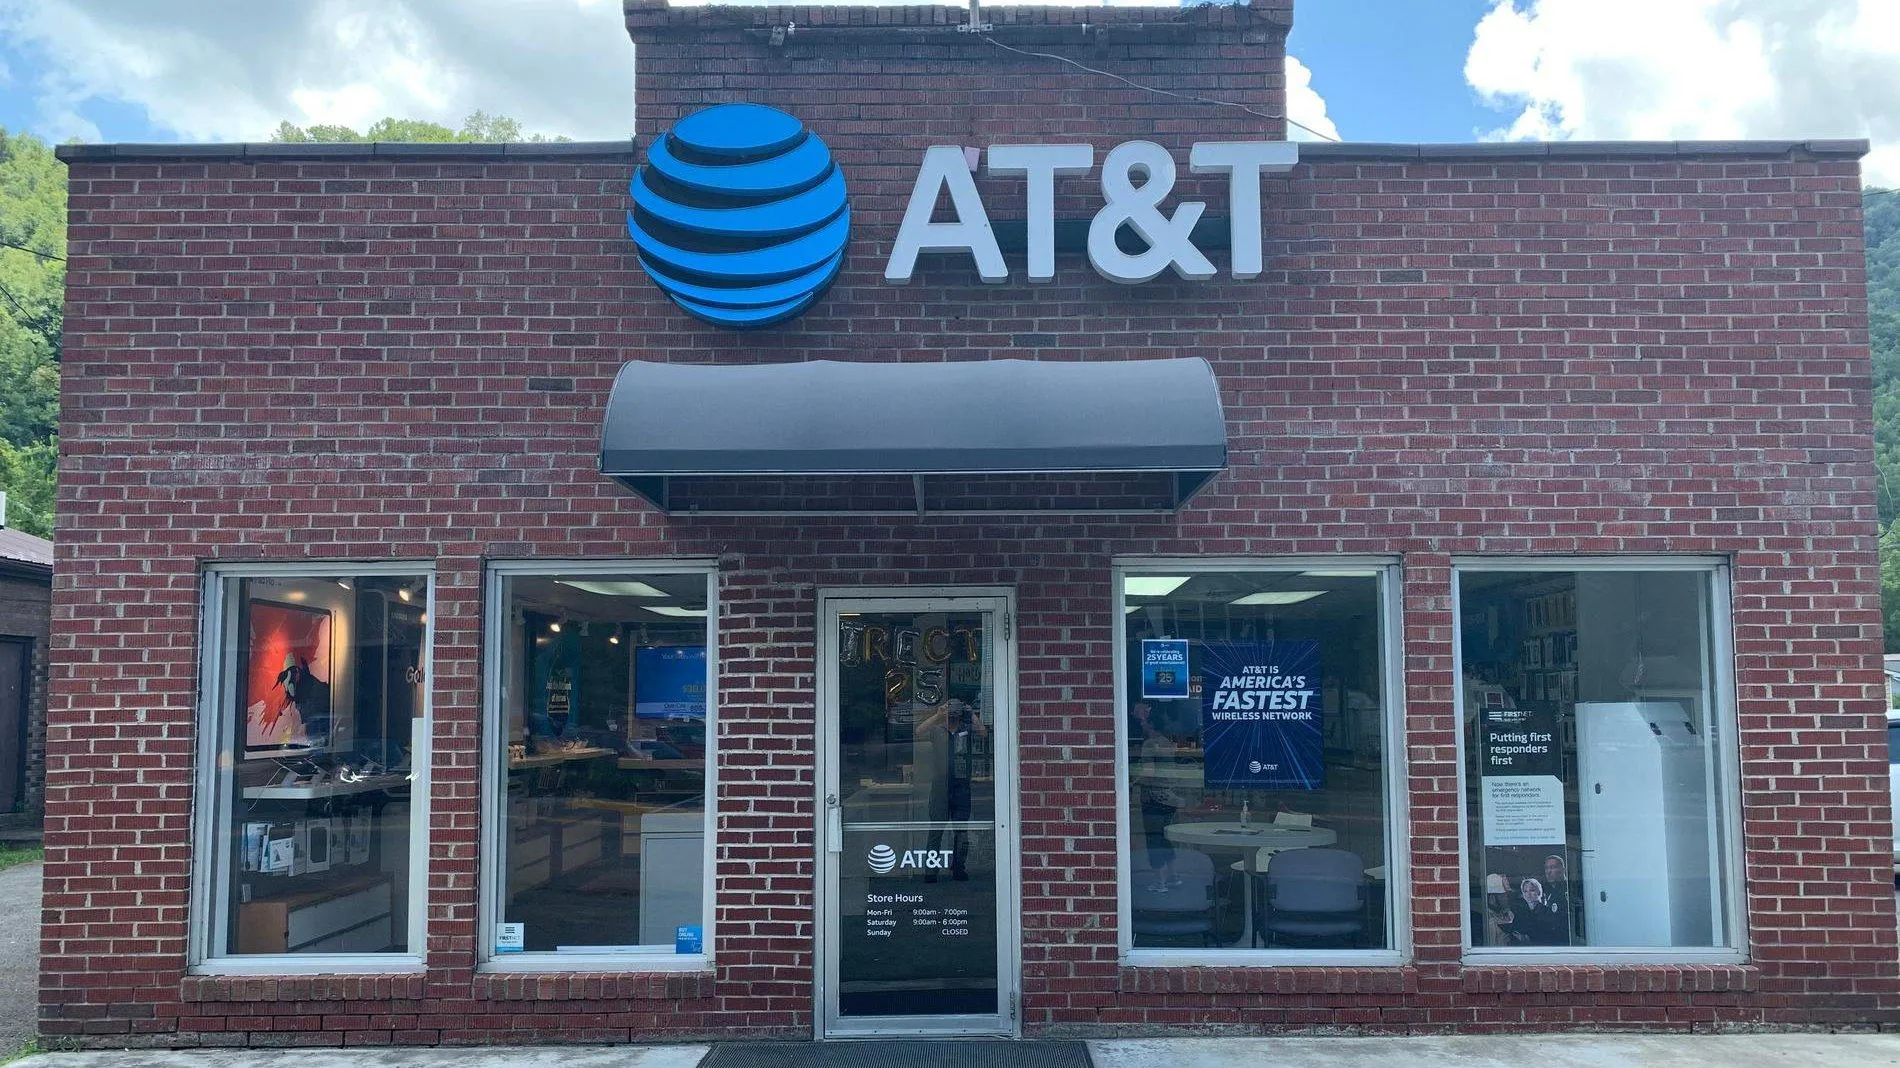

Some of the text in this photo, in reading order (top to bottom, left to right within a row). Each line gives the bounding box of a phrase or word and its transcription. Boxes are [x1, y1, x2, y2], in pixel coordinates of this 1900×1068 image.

[884, 140, 1299, 284] AT&T
[1156, 653, 1183, 661] YEARS
[1242, 665, 1279, 674] AT&T IS
[1219, 675, 1306, 689] AMERICA'S
[1211, 690, 1314, 710] FASTEST
[1211, 711, 1312, 720] WIRELESS NETWORK
[1490, 732, 1552, 744] Putting first
[1490, 744, 1548, 755] responders
[1490, 755, 1513, 765] first
[900, 849, 953, 869] AT&T
[867, 893, 924, 903] Store Hours
[944, 908, 968, 917] 7:00pm
[867, 919, 897, 927] Saturday
[942, 919, 968, 927] 6:00pm
[867, 928, 968, 937] Sunday CLOSED
